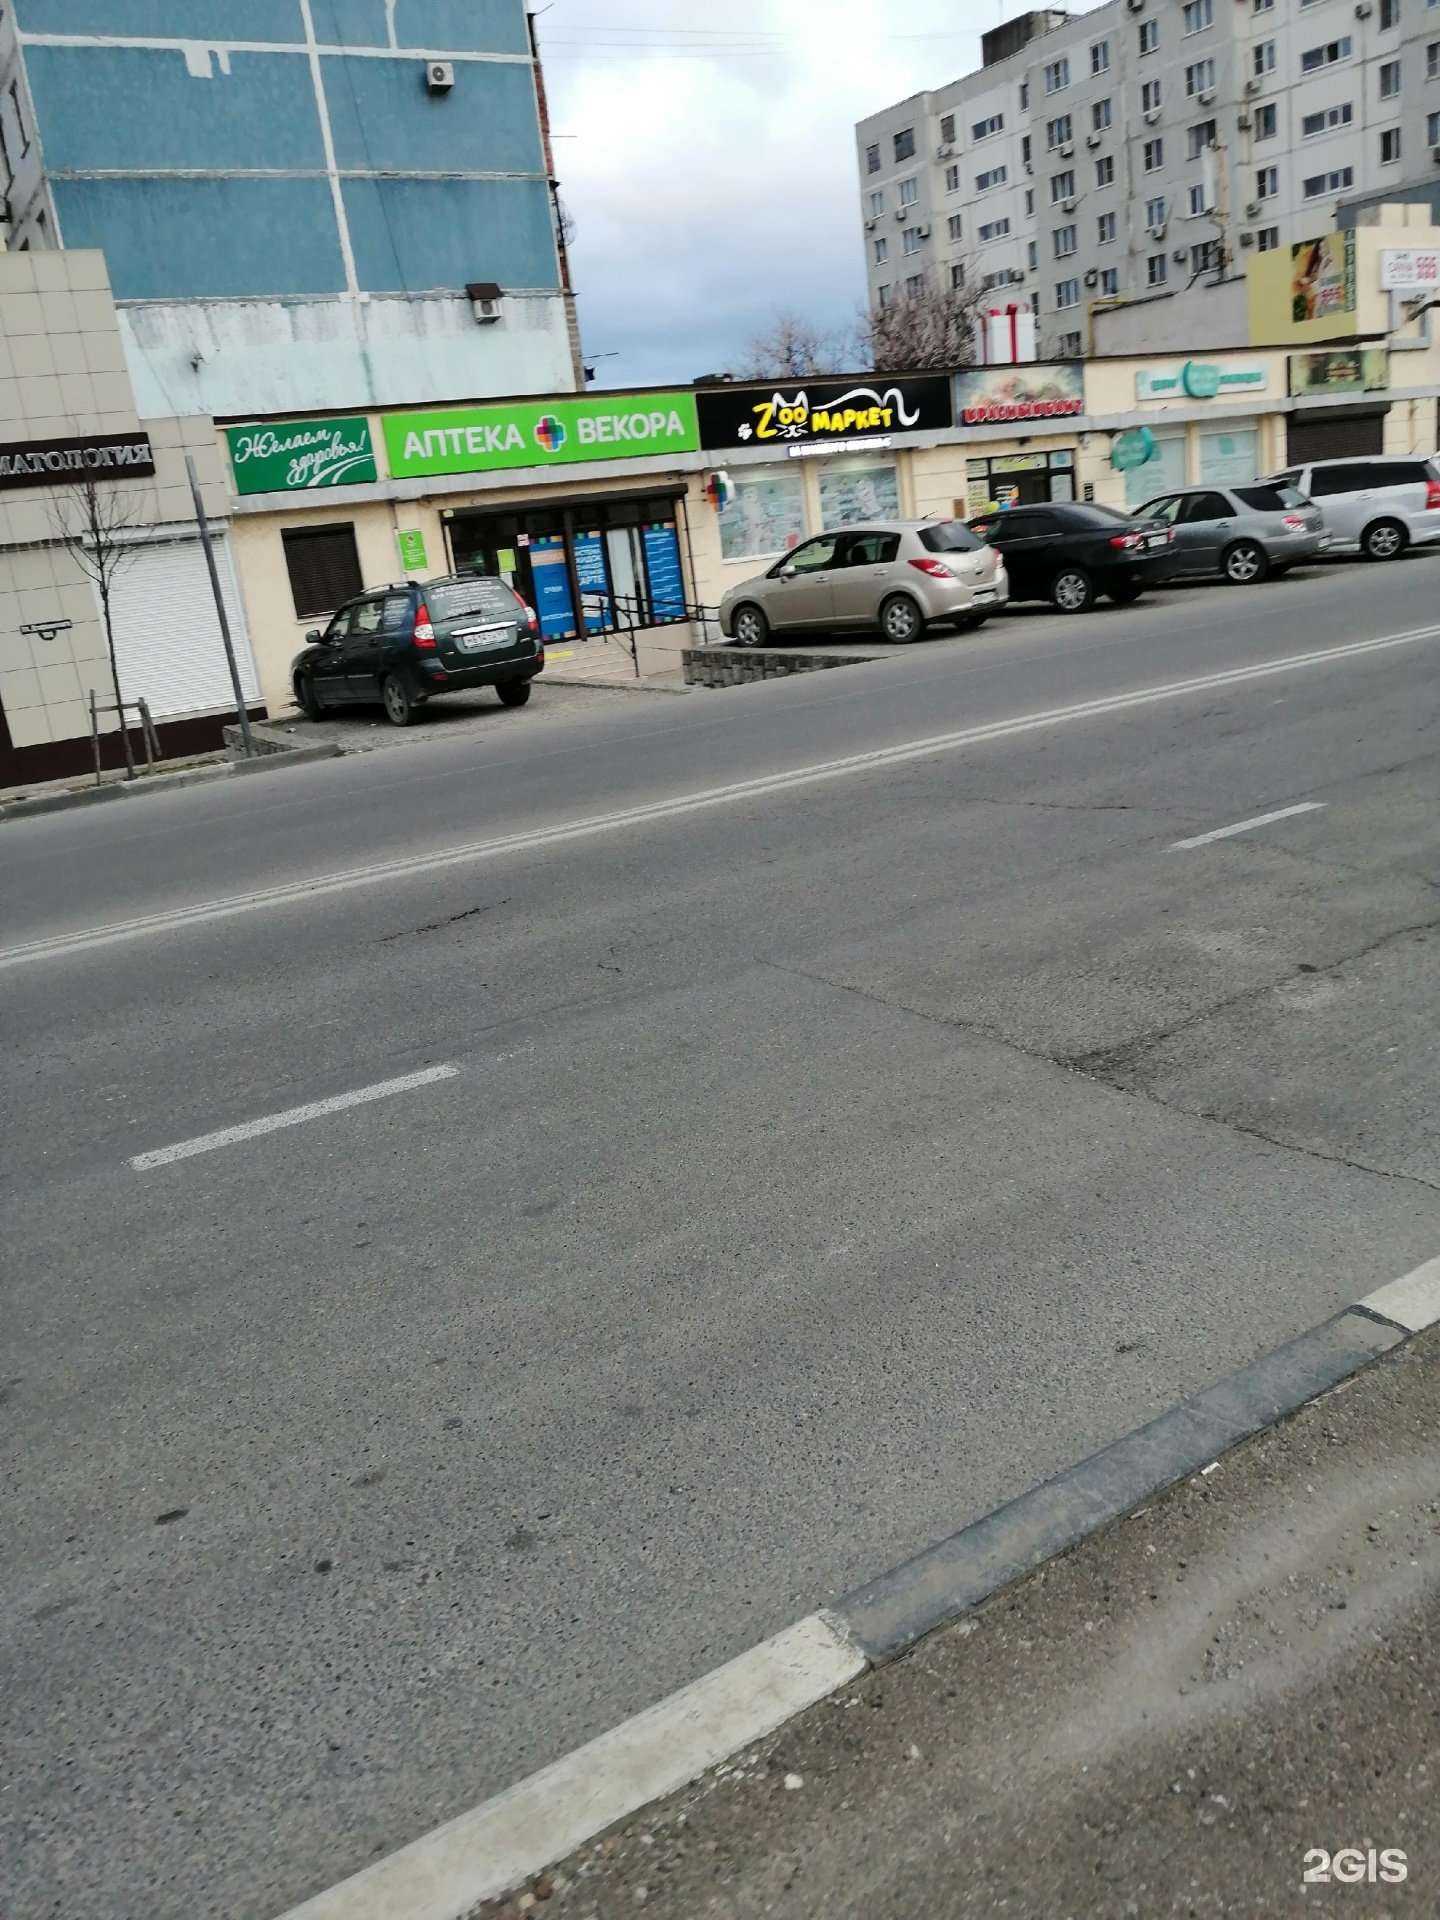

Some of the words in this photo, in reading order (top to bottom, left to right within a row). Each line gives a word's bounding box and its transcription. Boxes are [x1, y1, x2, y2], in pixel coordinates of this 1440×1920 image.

[234, 428, 331, 463] Желаем
[286, 430, 366, 486] здоровья!
[403, 424, 525, 460] АПТЕКА
[577, 411, 685, 444] ВЕКОРА
